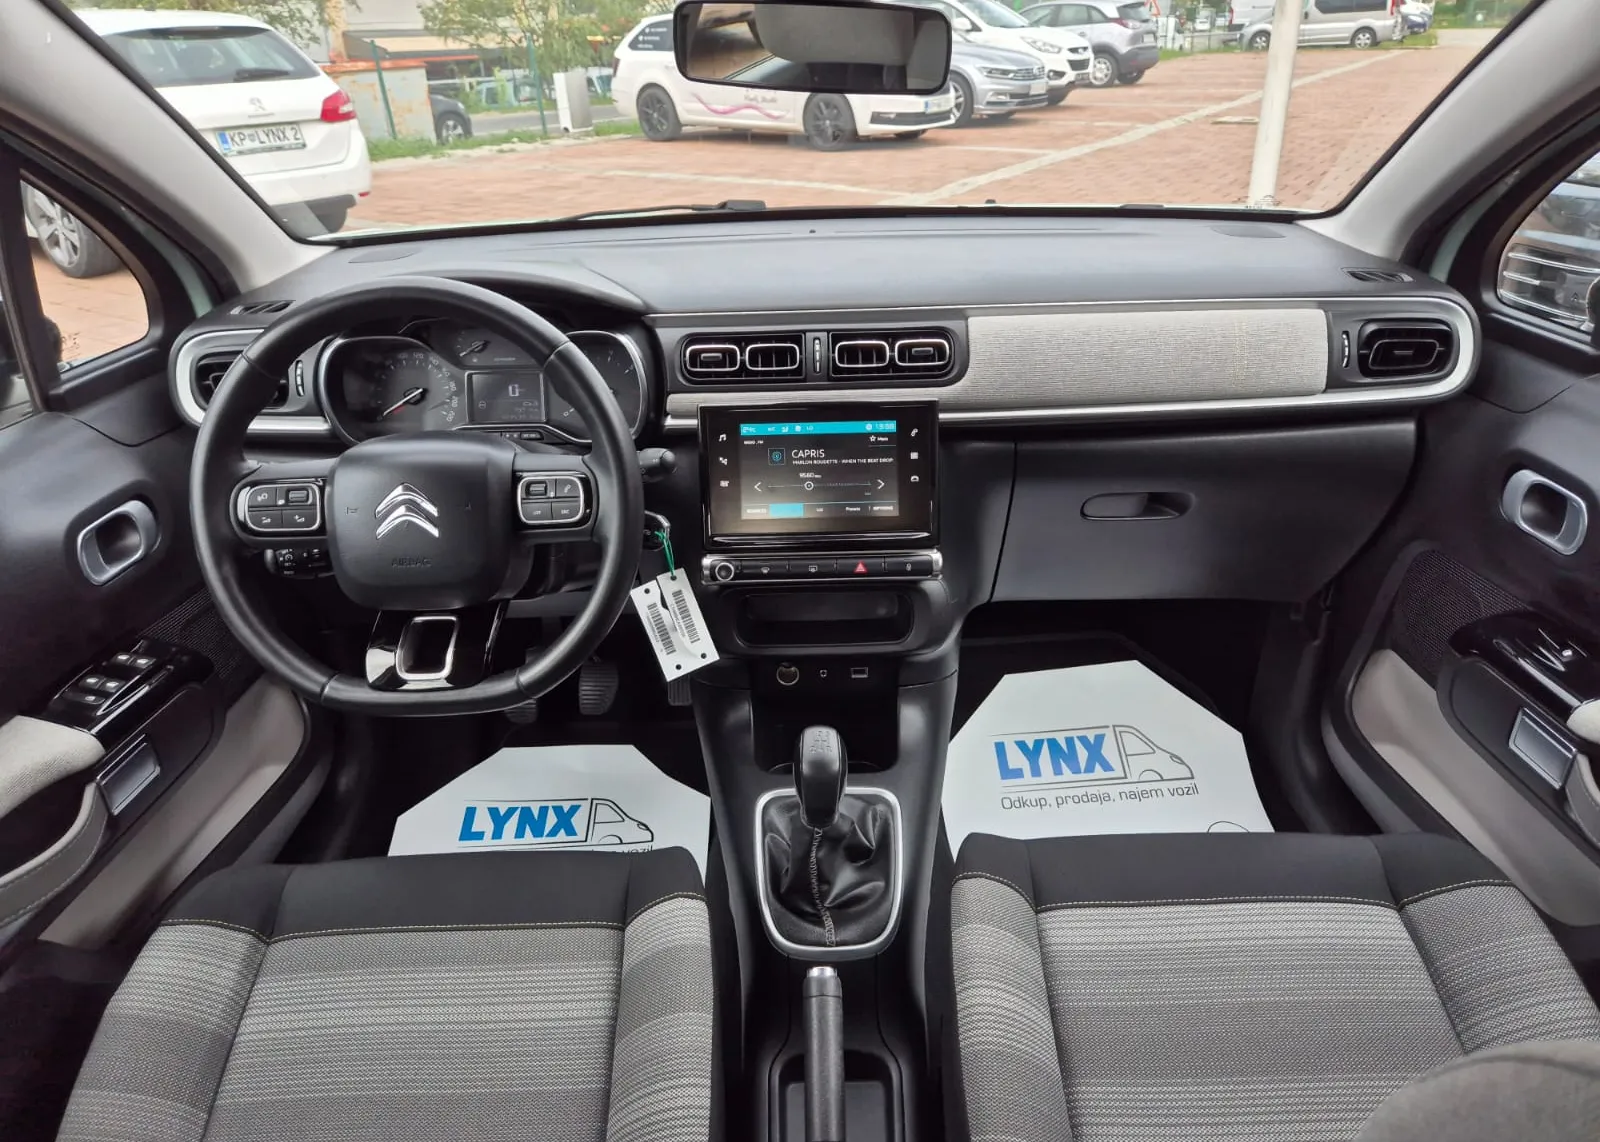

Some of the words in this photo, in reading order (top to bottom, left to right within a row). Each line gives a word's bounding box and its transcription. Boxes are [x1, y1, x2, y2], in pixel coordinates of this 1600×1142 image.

[229, 132, 247, 147] KP
[255, 127, 290, 145] LYNX
[291, 127, 300, 141] 2
[791, 449, 825, 459] CAPRIS
[994, 733, 1115, 781] LYNX
[1000, 795, 1052, 810] Odkup,
[1055, 790, 1115, 808] prodaja,
[1119, 786, 1164, 802] najem
[1168, 783, 1200, 798] vozil
[458, 804, 582, 842] LYNX
